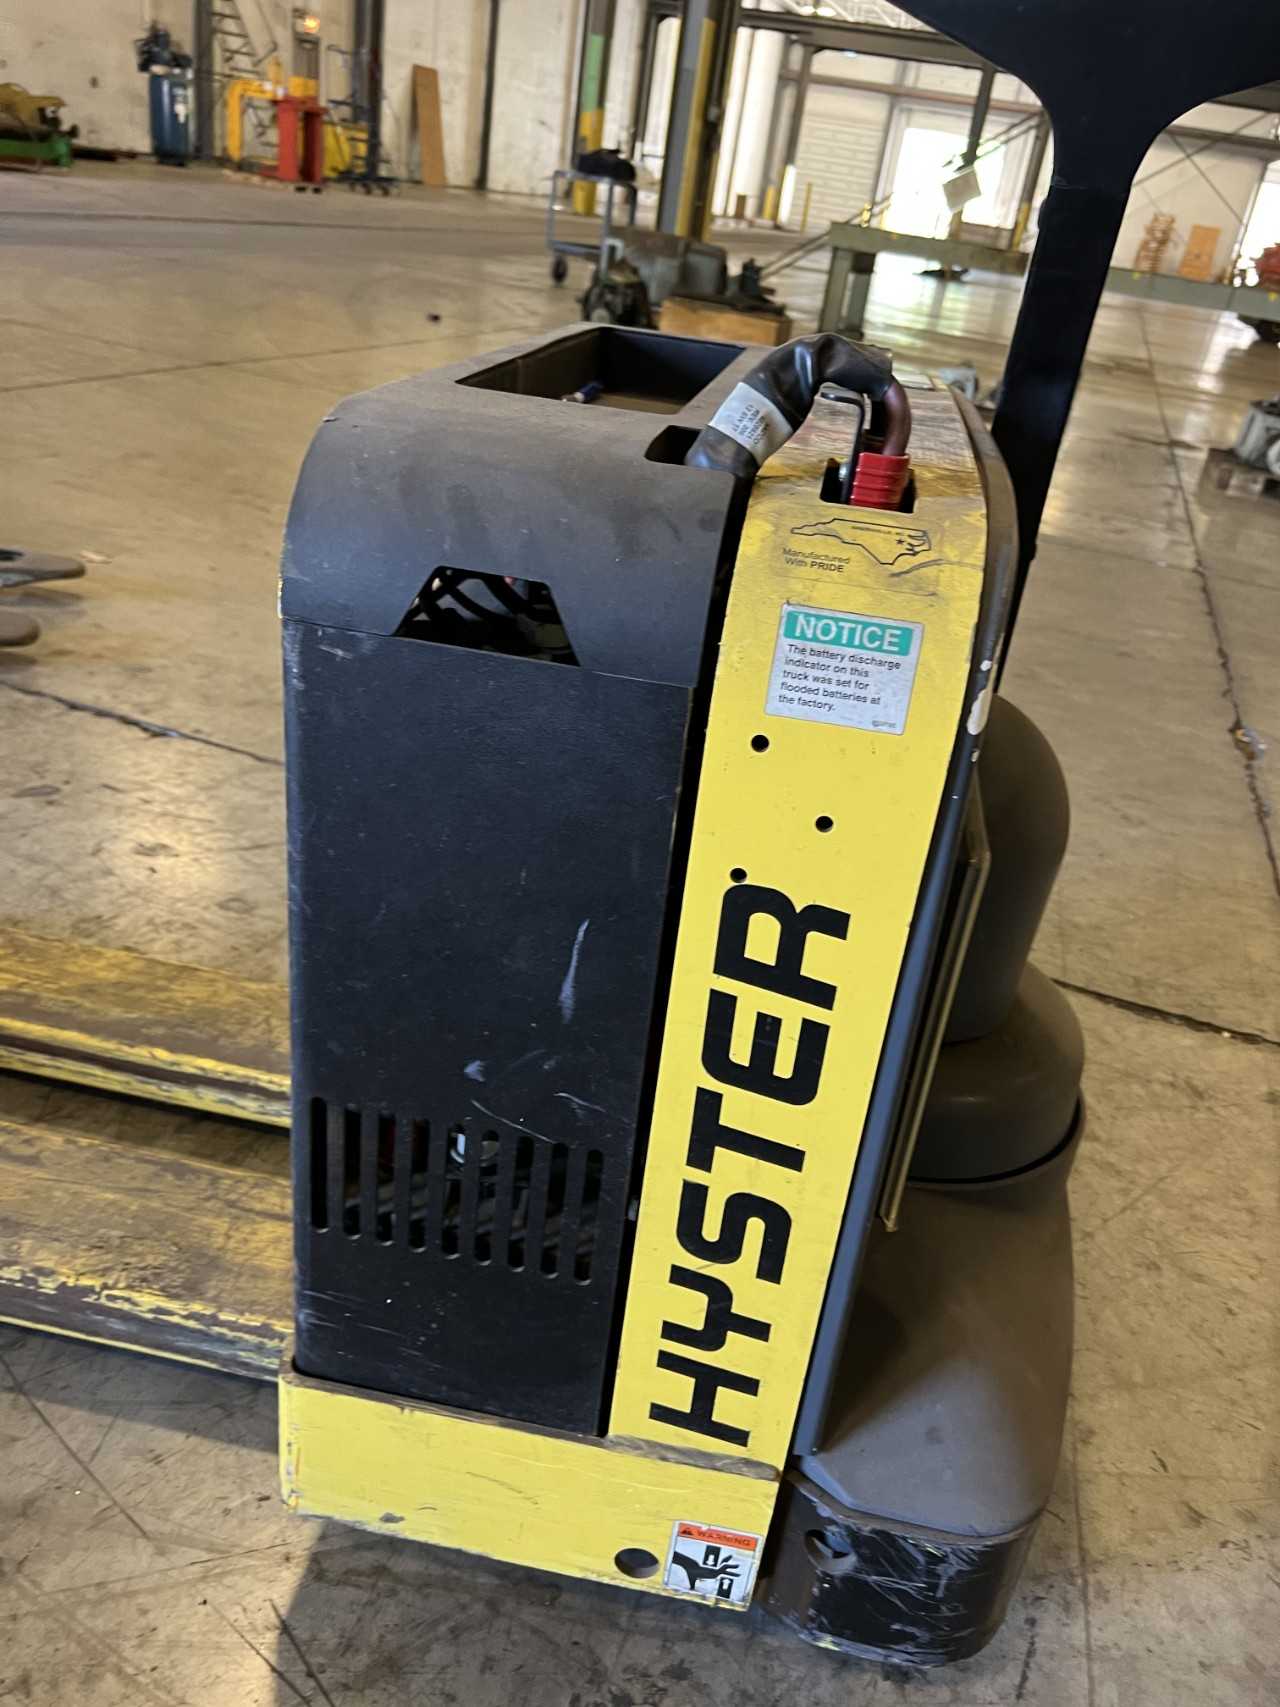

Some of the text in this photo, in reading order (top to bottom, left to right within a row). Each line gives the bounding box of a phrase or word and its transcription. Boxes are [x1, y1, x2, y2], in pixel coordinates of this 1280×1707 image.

[785, 557, 844, 572] With PRIDE
[794, 614, 903, 651] NOTICE
[785, 657, 869, 677] indicator on this
[788, 644, 901, 670] The battery discharge
[783, 669, 870, 690] truck was set for
[778, 694, 836, 712] the factory.
[781, 682, 881, 705] flooded batteries at
[649, 883, 851, 1447] HYSTER
[698, 1531, 751, 1546] WARNING
